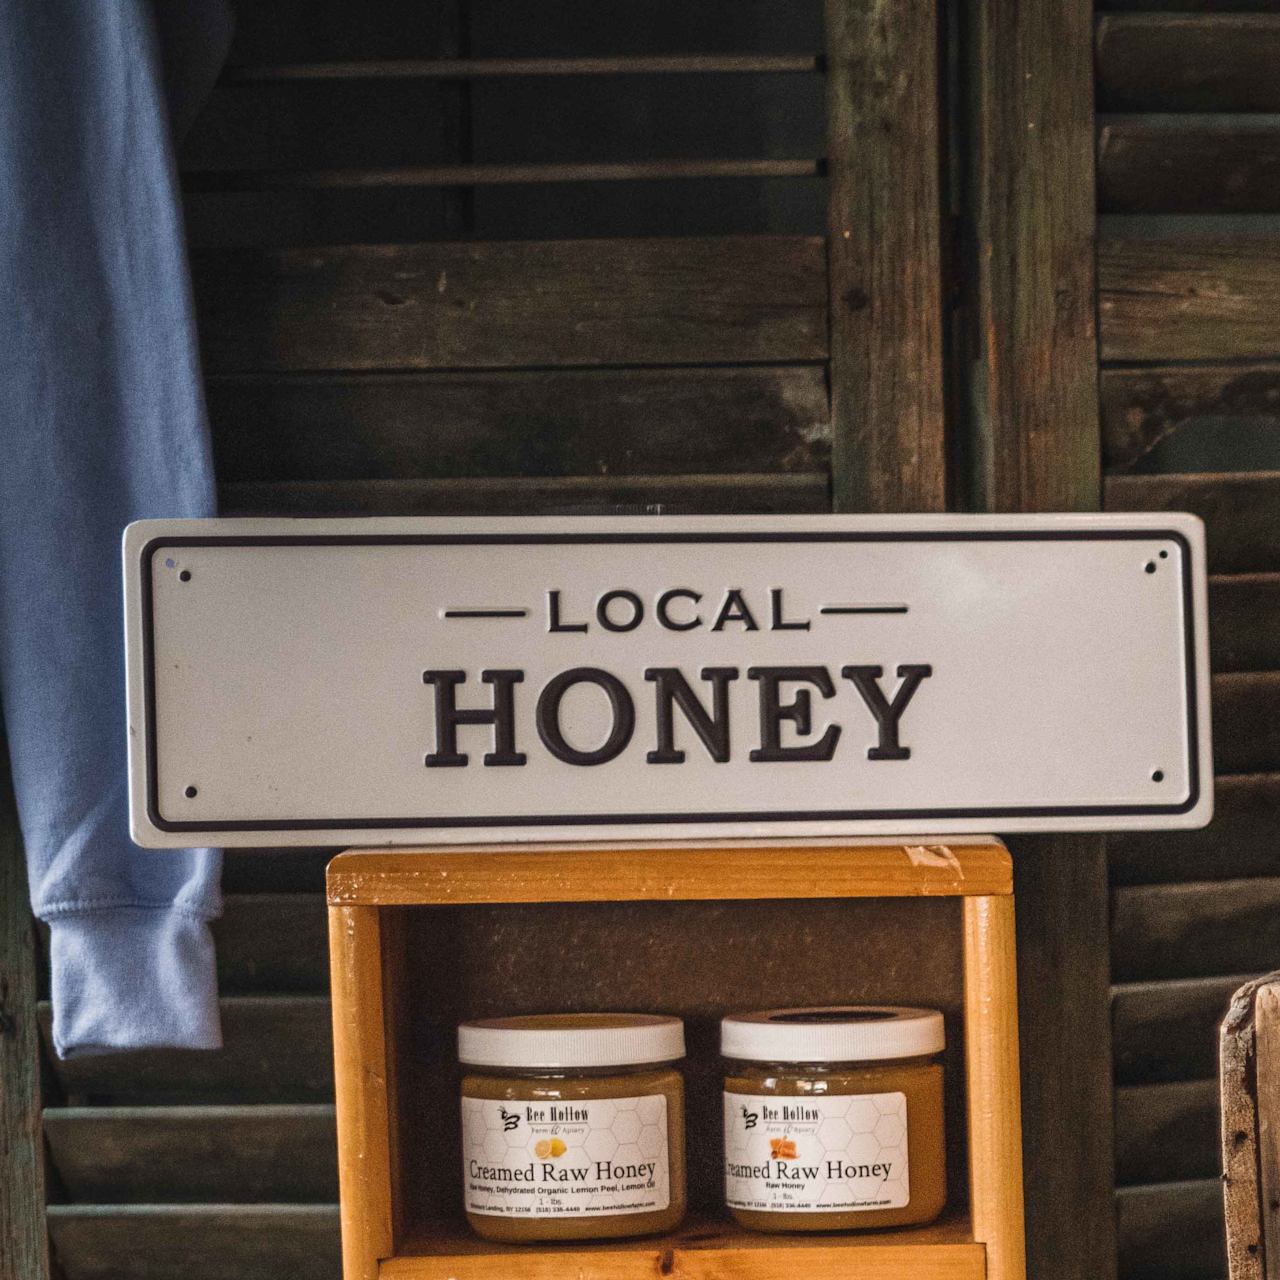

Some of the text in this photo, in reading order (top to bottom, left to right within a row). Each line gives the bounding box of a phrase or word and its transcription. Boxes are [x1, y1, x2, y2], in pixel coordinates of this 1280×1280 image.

[546, 587, 812, 634] LOCAL
[422, 663, 933, 766] HONEY
[526, 1106, 589, 1122] Bee Hollow
[763, 1106, 819, 1120] Bee Hollow
[470, 1159, 656, 1184] Creamed Raw Honey
[728, 1161, 892, 1182] reamed Raw Honey
